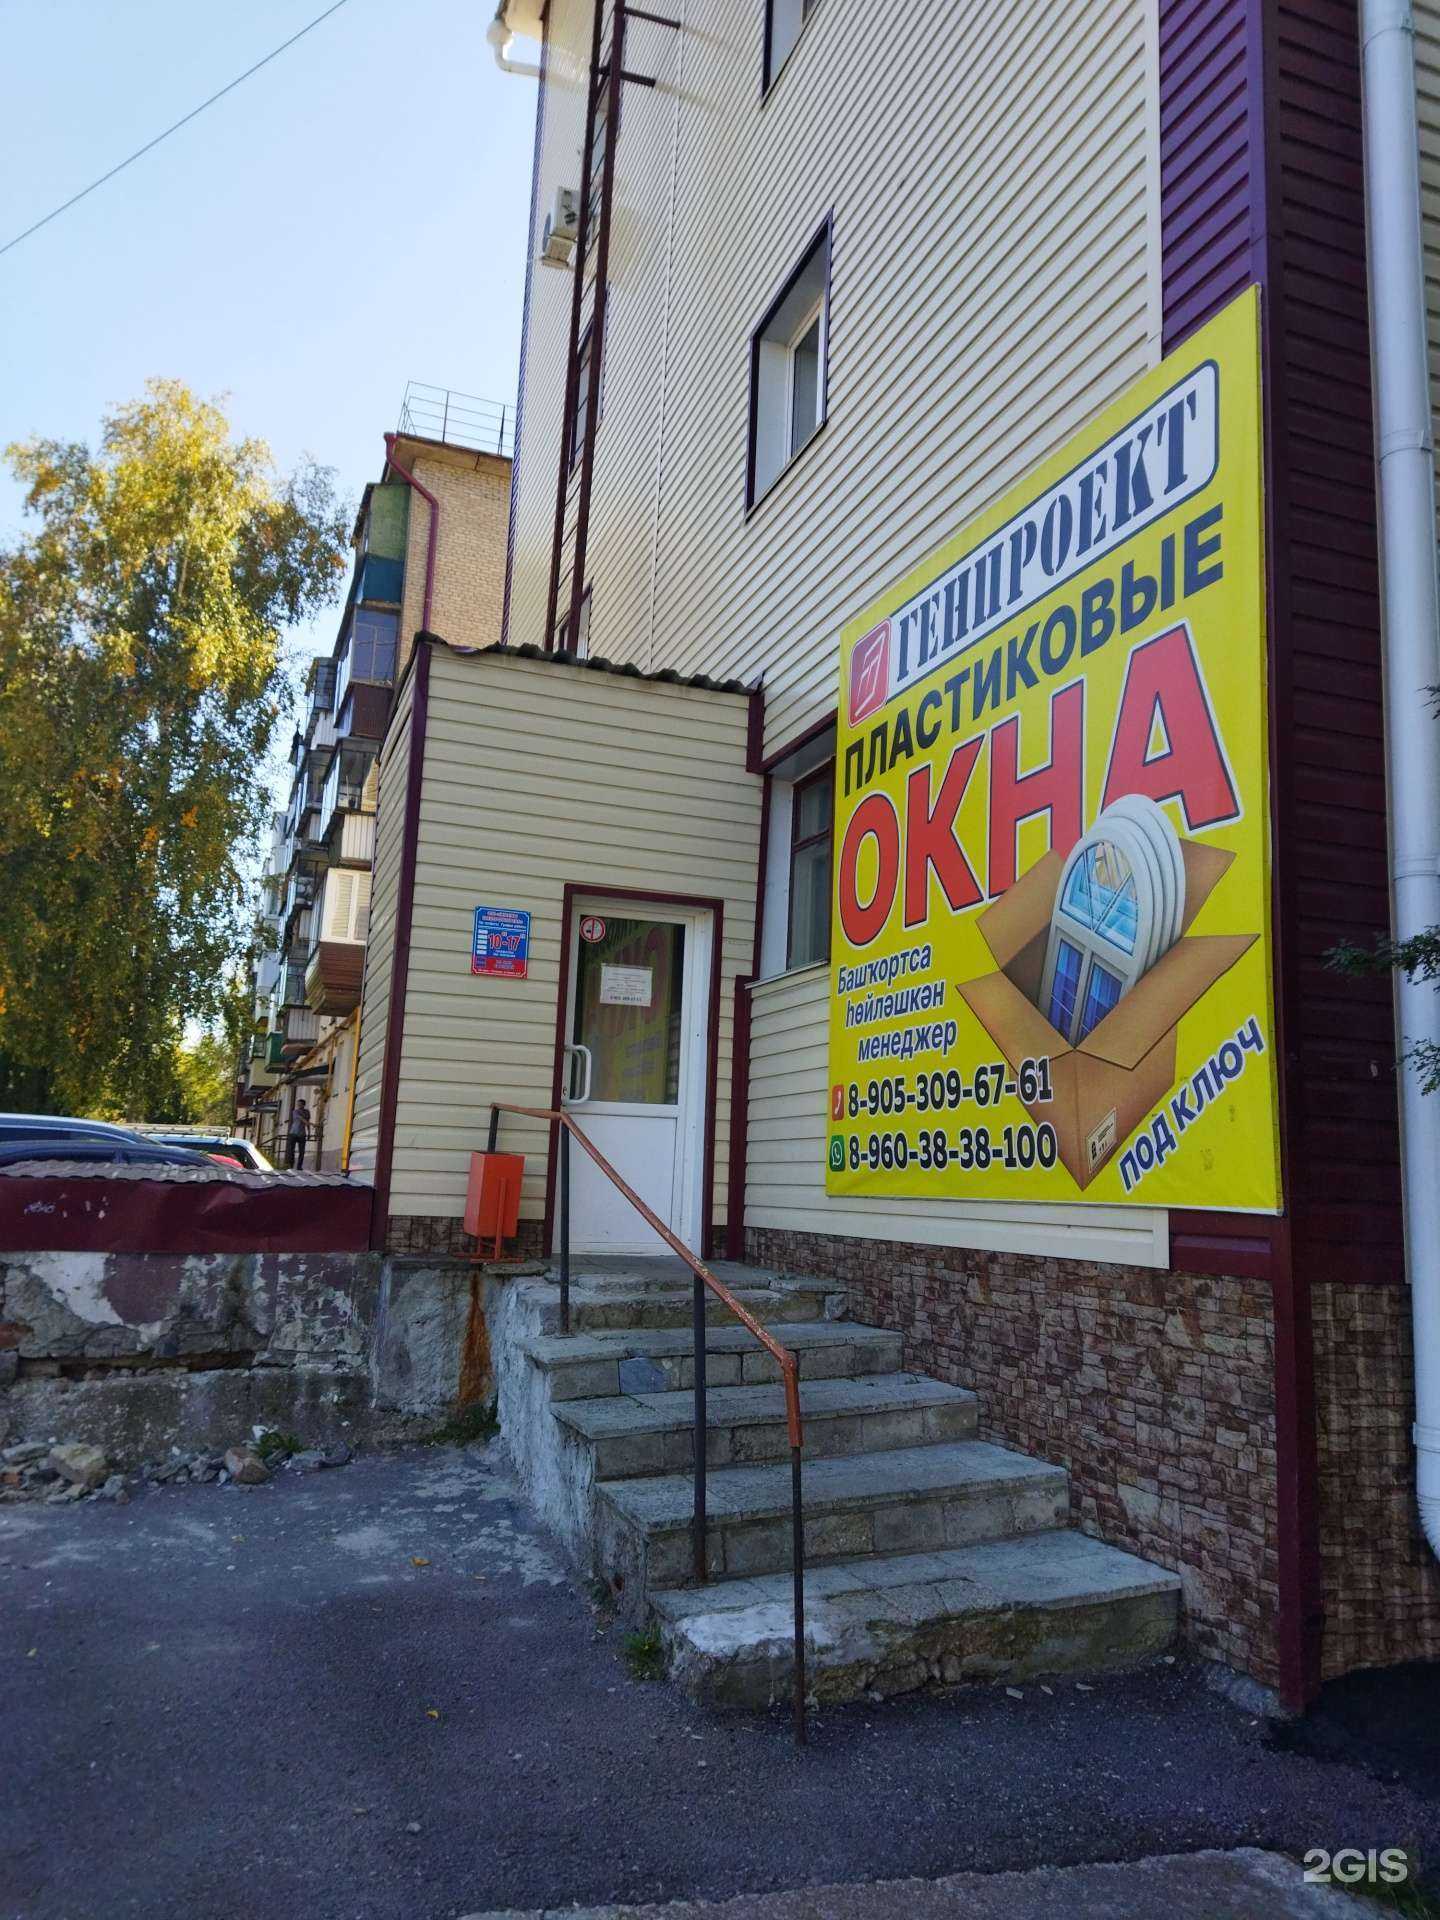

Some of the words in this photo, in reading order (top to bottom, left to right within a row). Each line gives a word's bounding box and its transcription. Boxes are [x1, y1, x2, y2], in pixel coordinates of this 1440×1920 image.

[896, 389, 1198, 683] ГЕНПРОЕКТ
[844, 502, 1223, 798] ПЛАСТИКОВЫЕ
[838, 620, 1242, 947] ОКНА
[848, 1057, 1053, 1118] 8-905-309-67-61
[857, 1020, 957, 1062] менеджер
[849, 1123, 1058, 1170] 8-960-38-38-100
